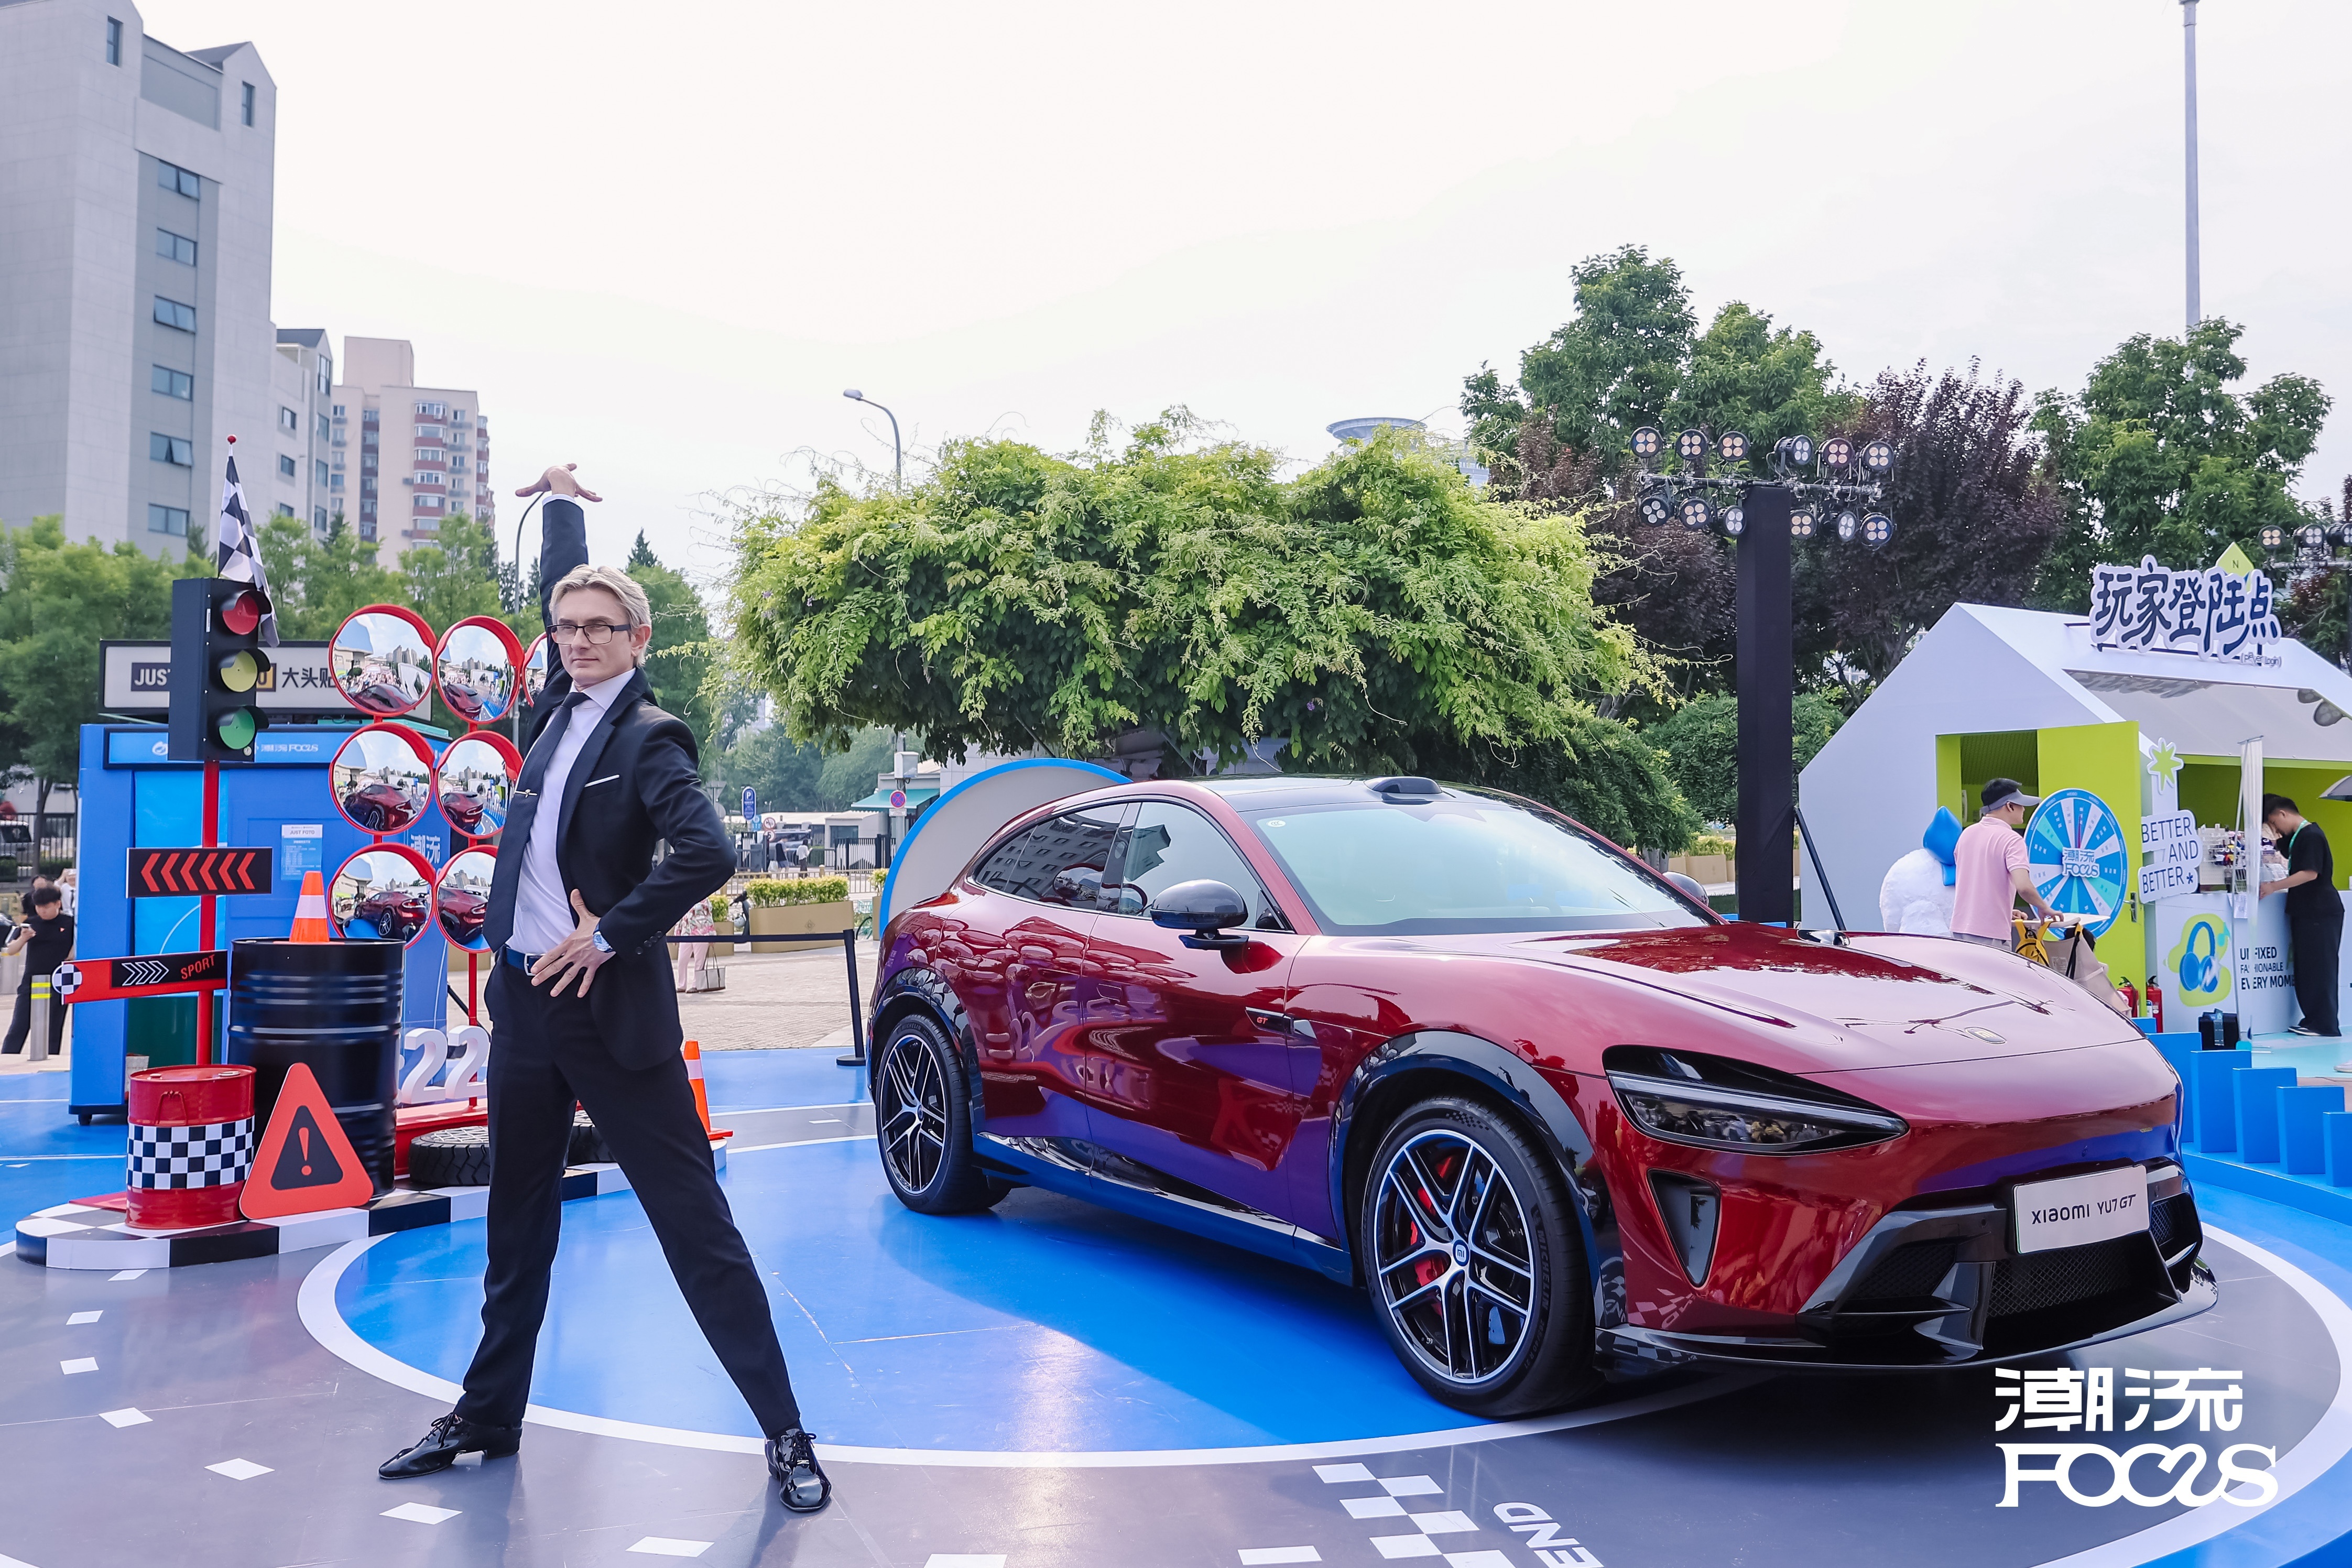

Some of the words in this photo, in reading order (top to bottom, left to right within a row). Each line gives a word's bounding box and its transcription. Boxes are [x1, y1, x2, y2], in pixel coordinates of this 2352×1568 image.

[134, 668, 171, 687] JUS
[2141, 816, 2192, 843] BETTER
[2064, 849, 2095, 863] 潮流
[2169, 840, 2198, 864] AND
[2065, 863, 2099, 877] FOCUS
[2142, 866, 2184, 894] BETTER
[181, 954, 215, 980] SPORT
[1537, 1229, 1550, 1310] MICHELIN
[1493, 1502, 1605, 1568] END
